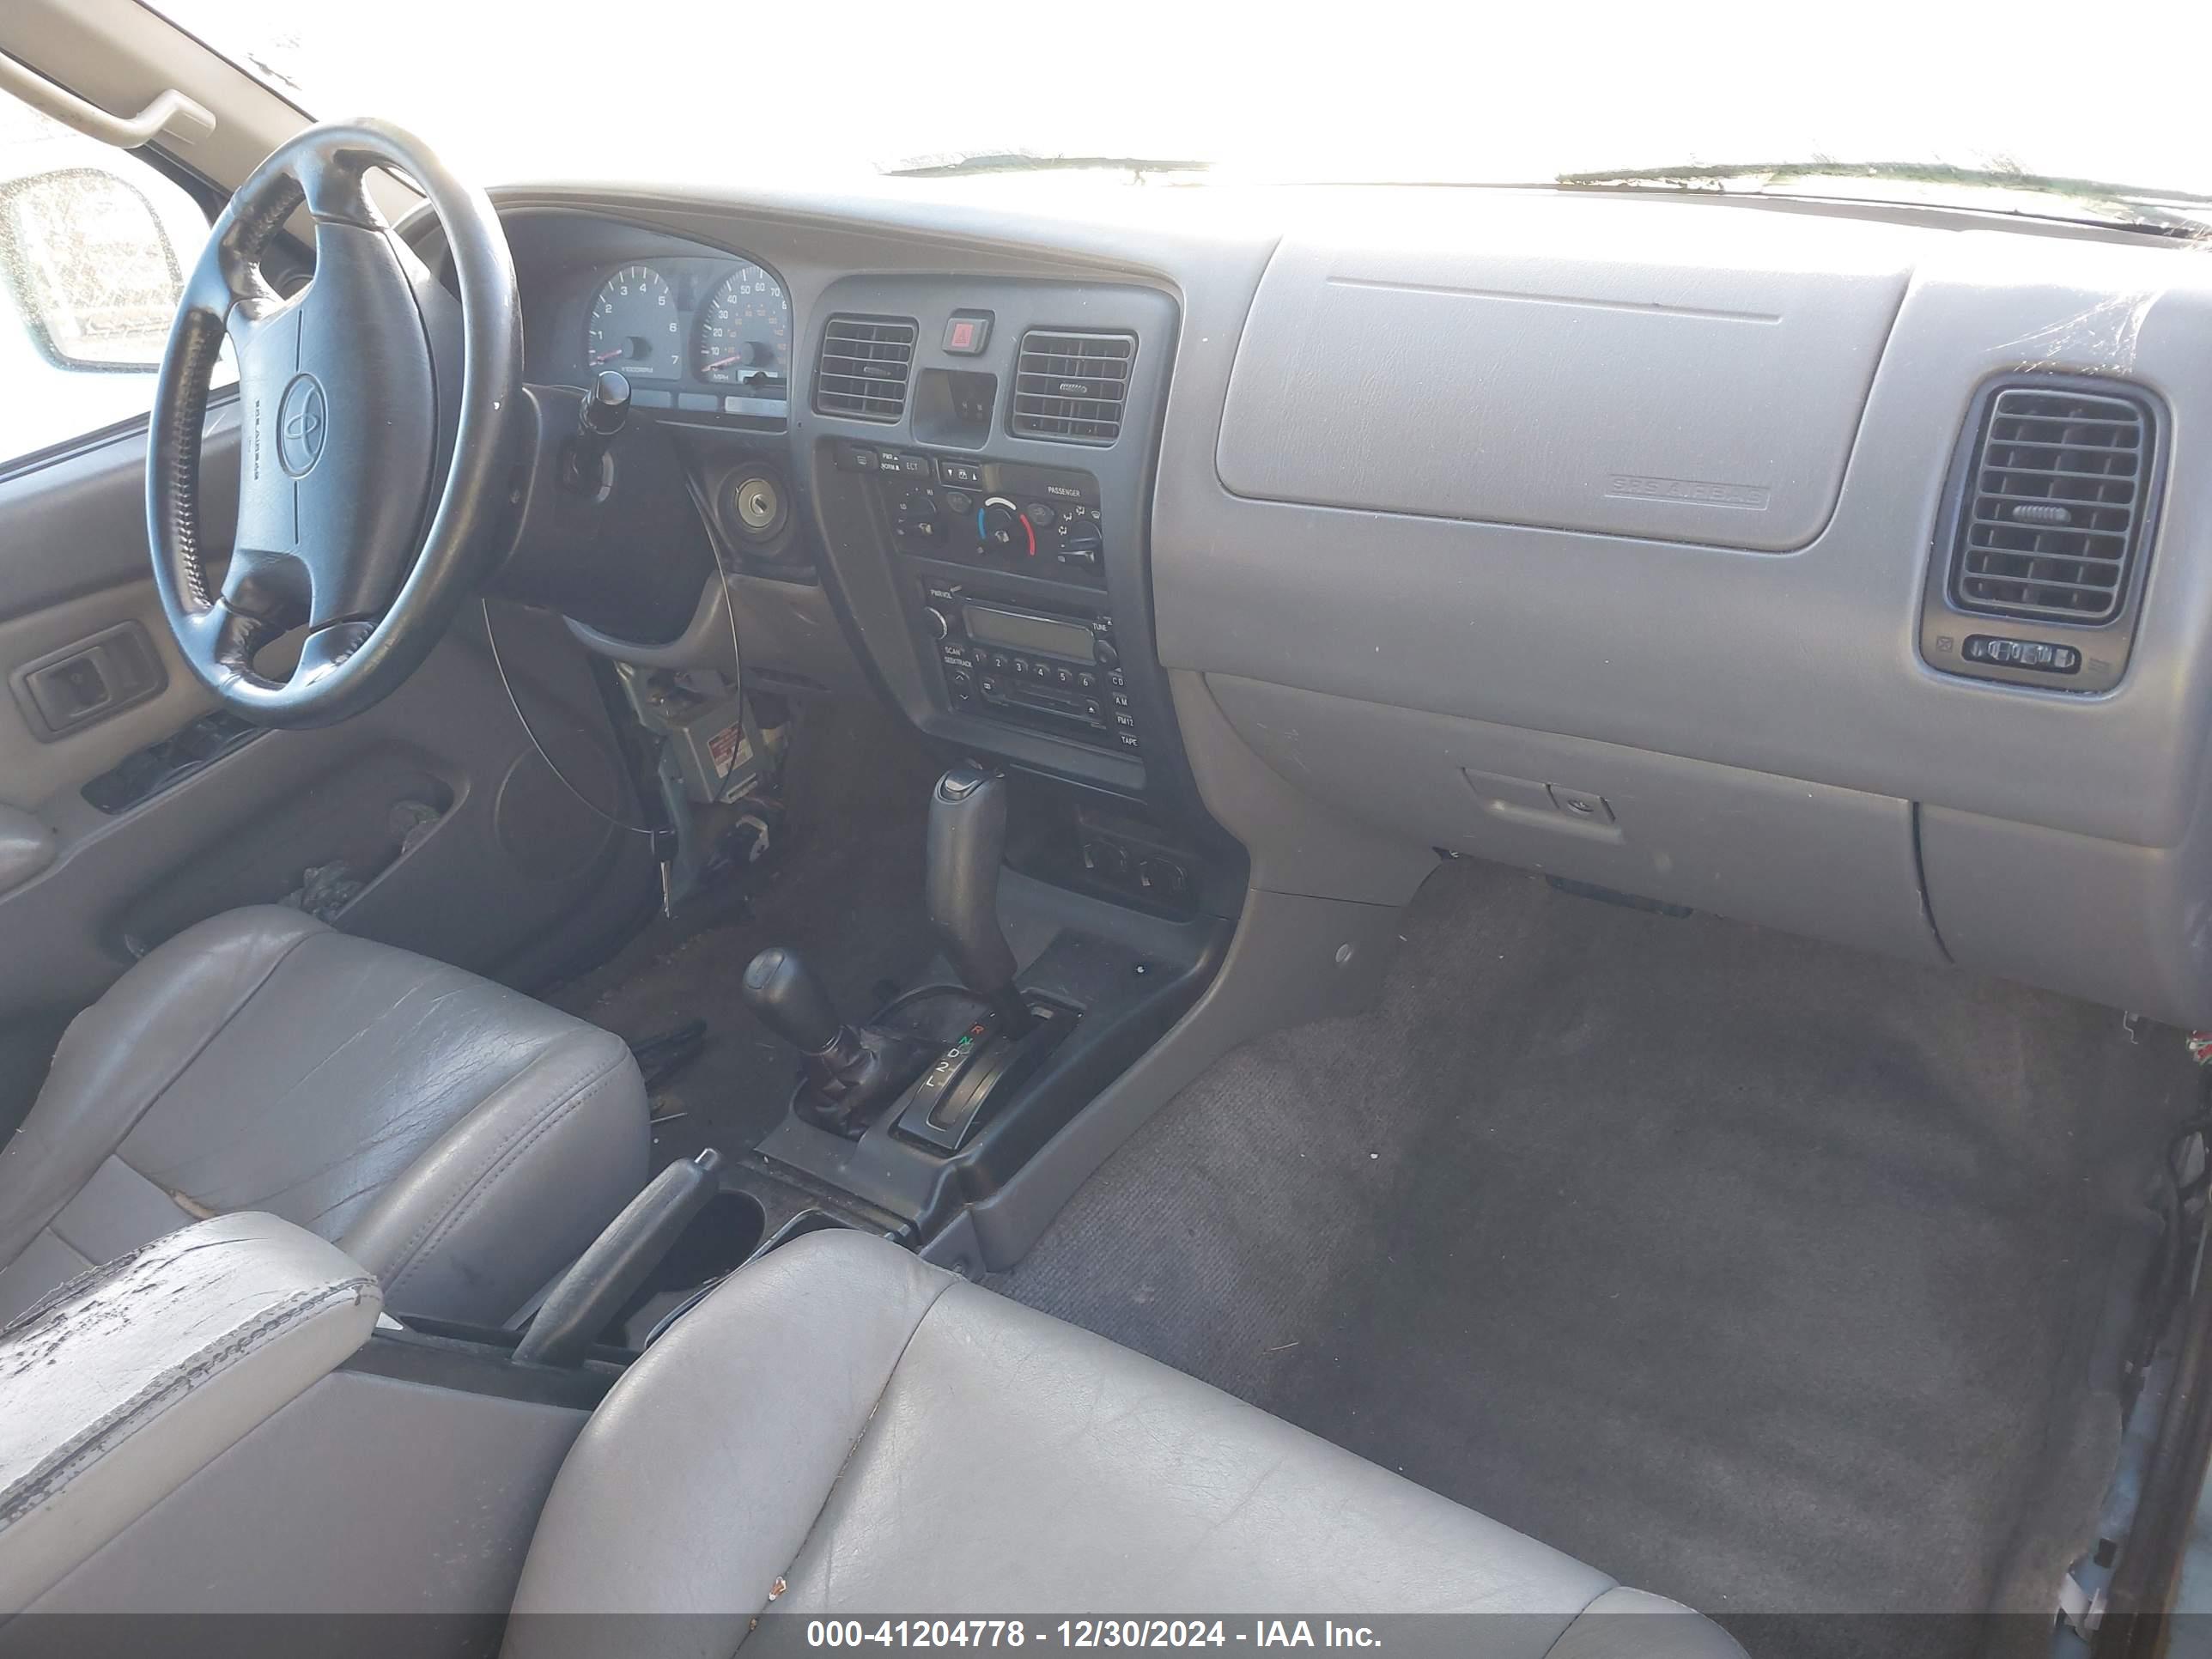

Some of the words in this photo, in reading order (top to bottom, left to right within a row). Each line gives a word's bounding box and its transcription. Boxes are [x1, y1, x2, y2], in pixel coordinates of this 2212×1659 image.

[620, 286, 628, 295] 3
[640, 283, 647, 293] 4
[740, 285, 750, 295] 50
[756, 283, 765, 292] 60
[771, 288, 781, 297] 70
[659, 295, 665, 306] 5
[727, 295, 737, 304] 40
[605, 304, 612, 313] 2
[718, 310, 728, 319] 30
[669, 323, 678, 332] 6
[598, 331, 603, 340] 1
[713, 328, 723, 337] 20
[711, 346, 720, 356] 10
[672, 355, 679, 365] 7
[1047, 485, 1081, 498] PASSENGER
[975, 653, 980, 662] 1
[996, 659, 1001, 667] 2
[1017, 663, 1022, 672] 3
[1038, 668, 1043, 677] 4
[1060, 672, 1066, 681] 5
[1083, 678, 1088, 687] 6
[1121, 736, 1138, 746] TAPE
[970, 1024, 985, 1035] R
[959, 1036, 973, 1045] N
[947, 1048, 960, 1059] D
[936, 1061, 950, 1073] 2
[926, 1075, 935, 1088] L
